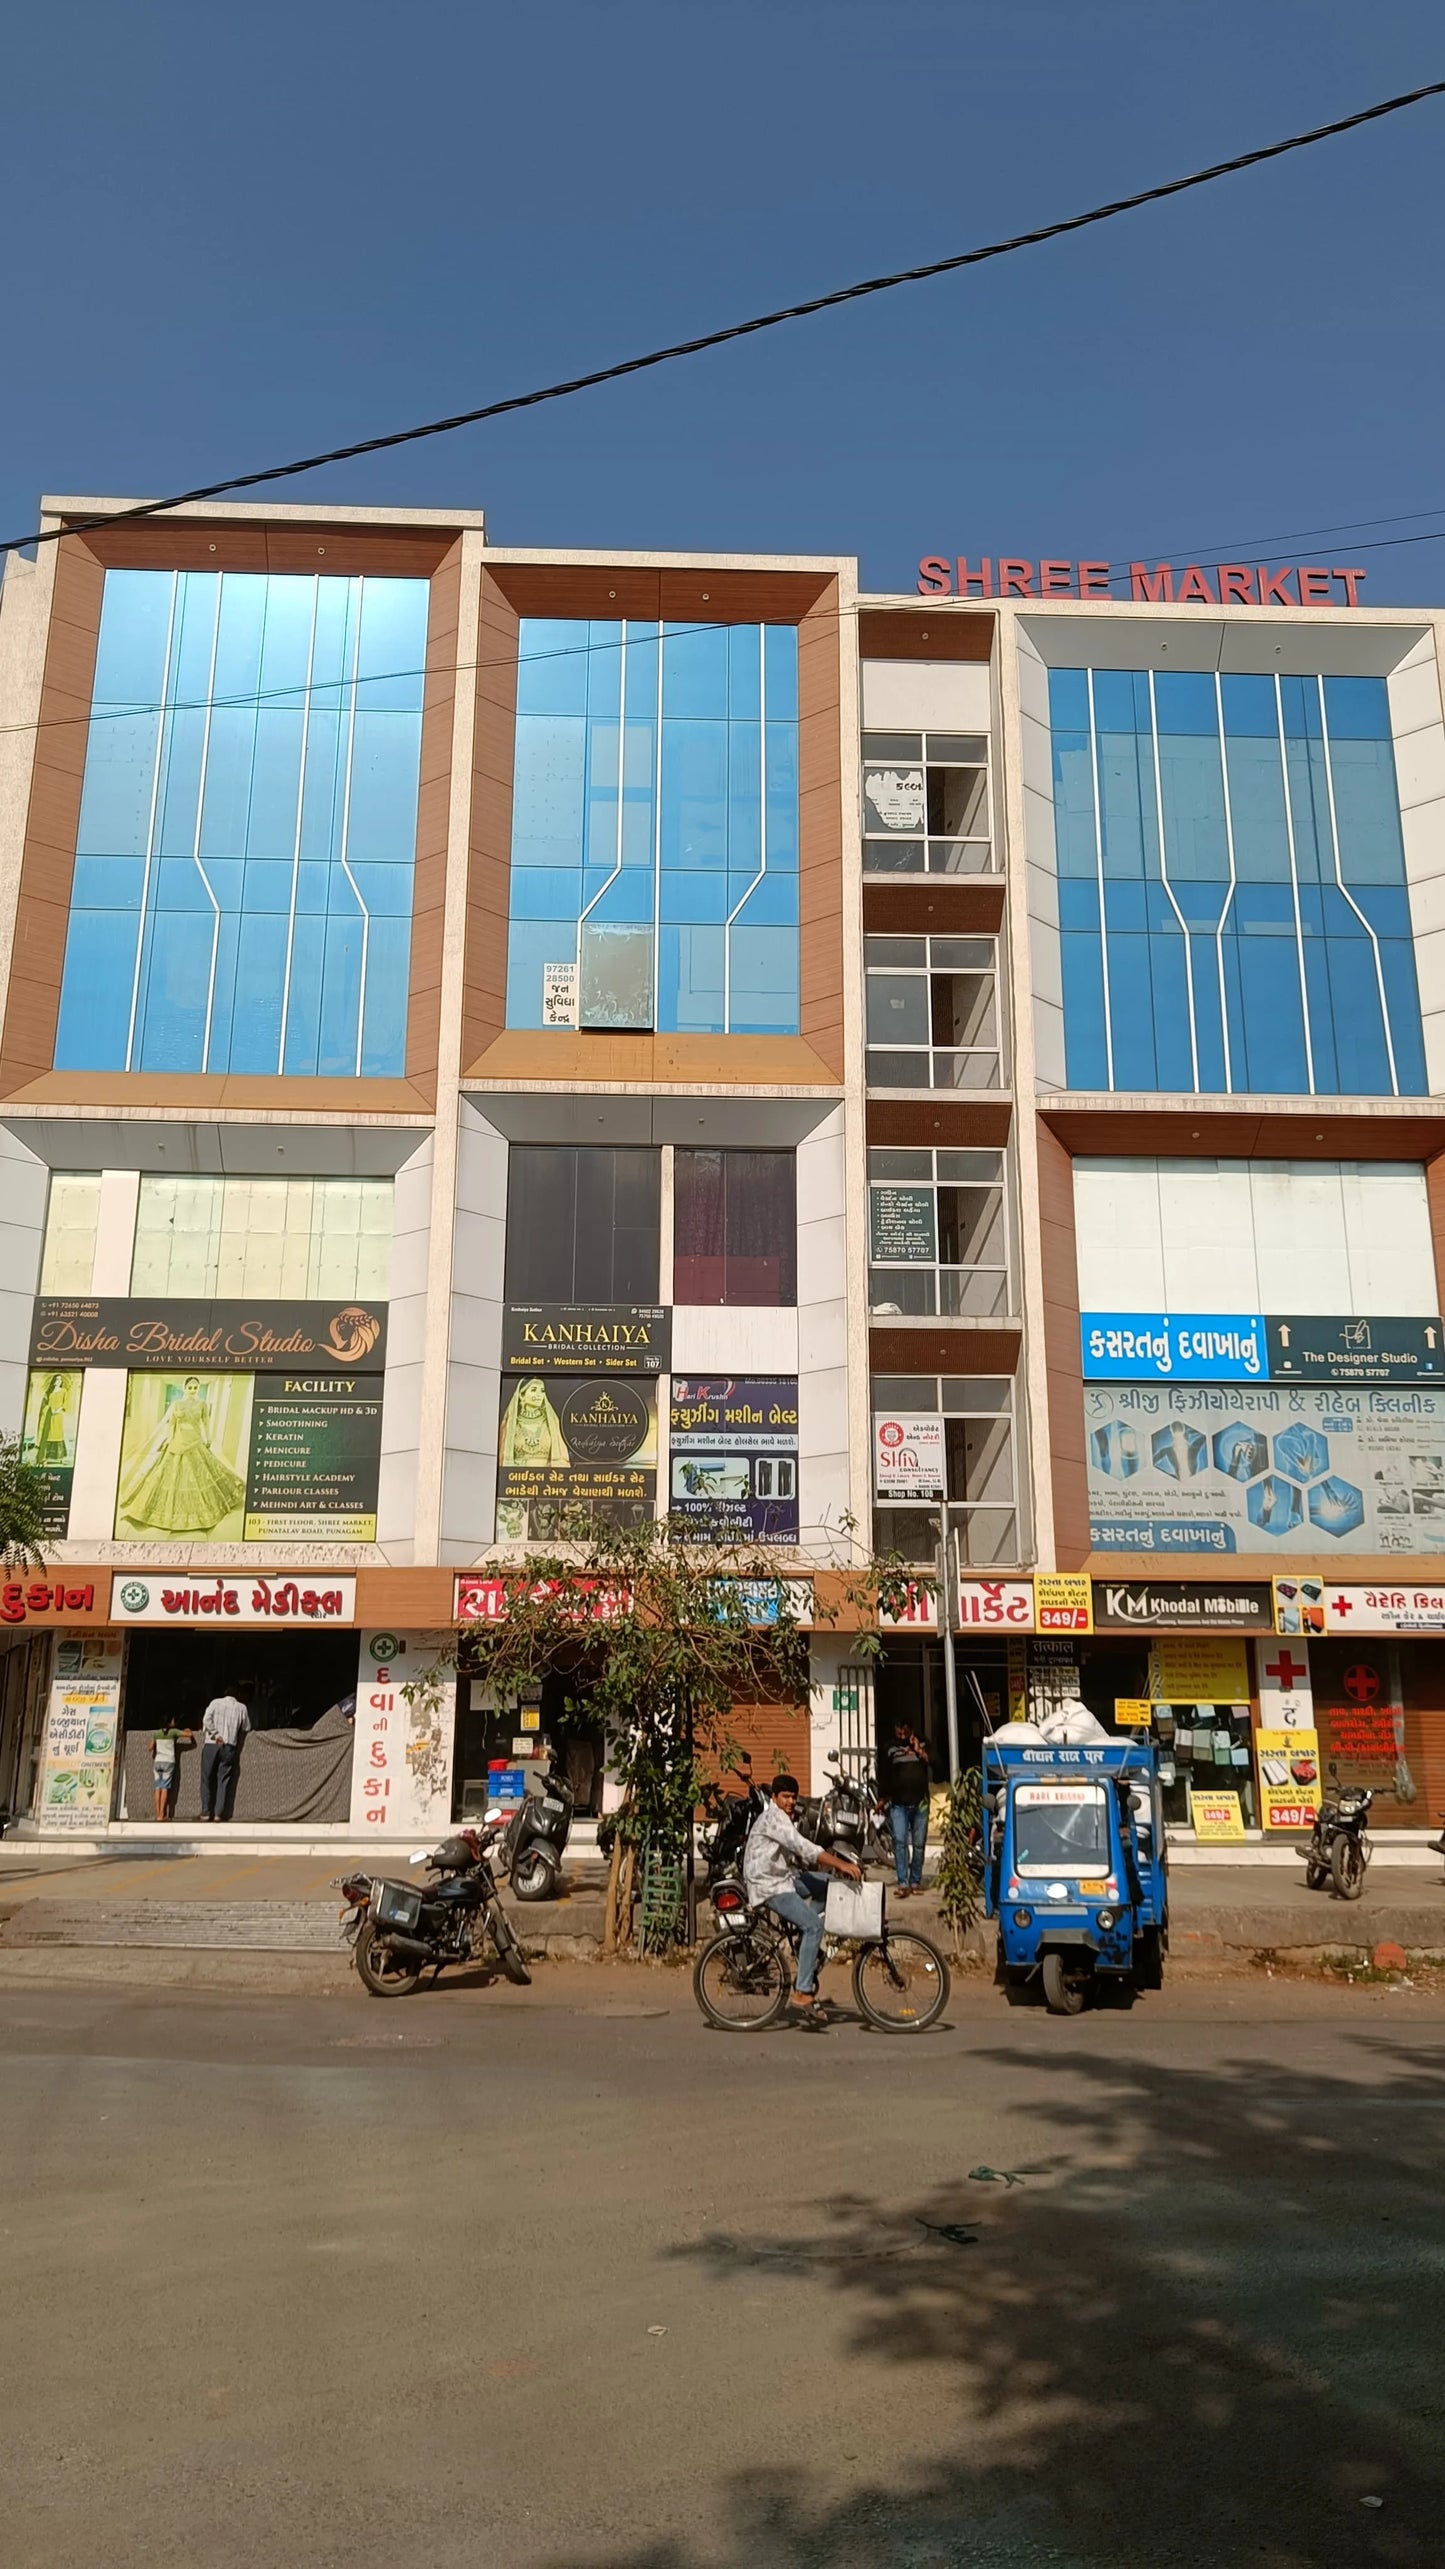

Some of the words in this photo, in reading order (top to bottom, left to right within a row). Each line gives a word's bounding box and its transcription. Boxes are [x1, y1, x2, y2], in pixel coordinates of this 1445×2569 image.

[917, 555, 1112, 600] SHREE
[1128, 561, 1367, 607] MARKET
[545, 995, 574, 1010] સુવિધા
[549, 1012, 569, 1023] કેન્દ્ર
[37, 1320, 120, 1351] Disha
[126, 1322, 222, 1353] Bridal
[224, 1321, 315, 1355] Studio
[523, 1324, 650, 1343] KANHAIYA
[1089, 1318, 1173, 1373] કસરતનું
[1178, 1319, 1261, 1373] દવાખાનું
[146, 1355, 172, 1363] LOVE
[510, 1357, 531, 1365] Bridal
[1303, 1351, 1325, 1362] The
[1328, 1352, 1378, 1365] Designer
[1382, 1353, 1418, 1363] Studio
[285, 1380, 356, 1392] FACILITY
[1288, 1389, 1306, 1412] &
[268, 1406, 300, 1414] BRIDAL
[725, 1405, 762, 1424] મશીન
[570, 1413, 638, 1424] KANHAIYA
[312, 1474, 355, 1482] ACADEMY
[888, 1490, 905, 1498] Shop
[1091, 1522, 1154, 1548] કસરતનું
[1161, 1523, 1227, 1548] દવાખાનું
[0, 1583, 94, 1623] દુકાન
[161, 1578, 240, 1615] આનંદ
[252, 1578, 343, 1616] મેડીકલ
[1151, 1598, 1200, 1613] Khodal
[1042, 1609, 1086, 1628] 349/-
[1271, 1807, 1314, 1825] 349/-
